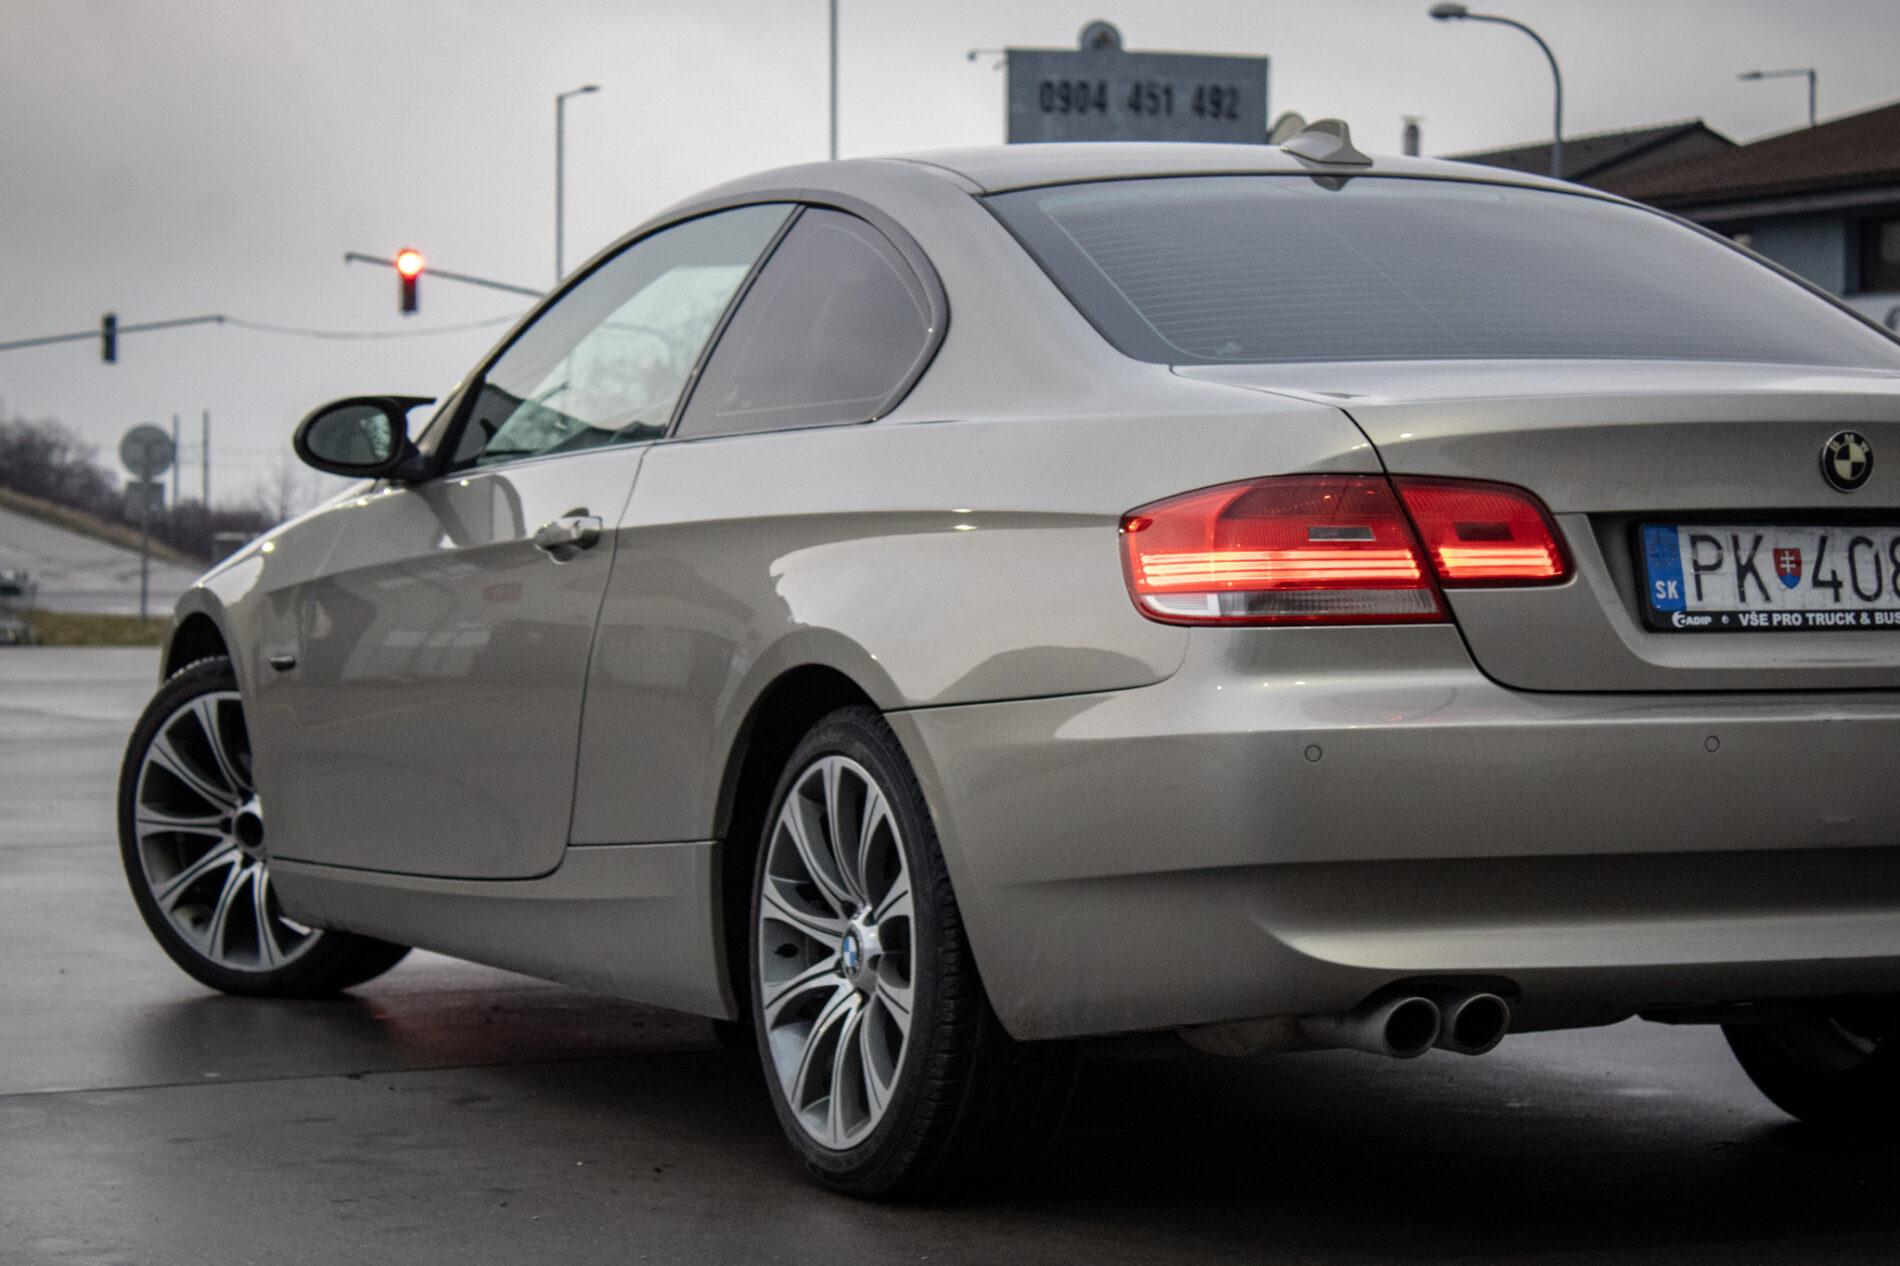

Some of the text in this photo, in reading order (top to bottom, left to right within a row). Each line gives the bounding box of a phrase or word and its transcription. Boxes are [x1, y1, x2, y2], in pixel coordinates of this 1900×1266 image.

[1039, 80, 1239, 120] 0904 451 492
[1829, 433, 1870, 452] BMW
[1690, 534, 1772, 602] PK
[1655, 580, 1680, 599] SK
[1738, 611, 1769, 626] VŠE
[1772, 612, 1802, 626] PRO
[1805, 611, 1856, 626] TRUCK
[1860, 611, 1871, 625] &
